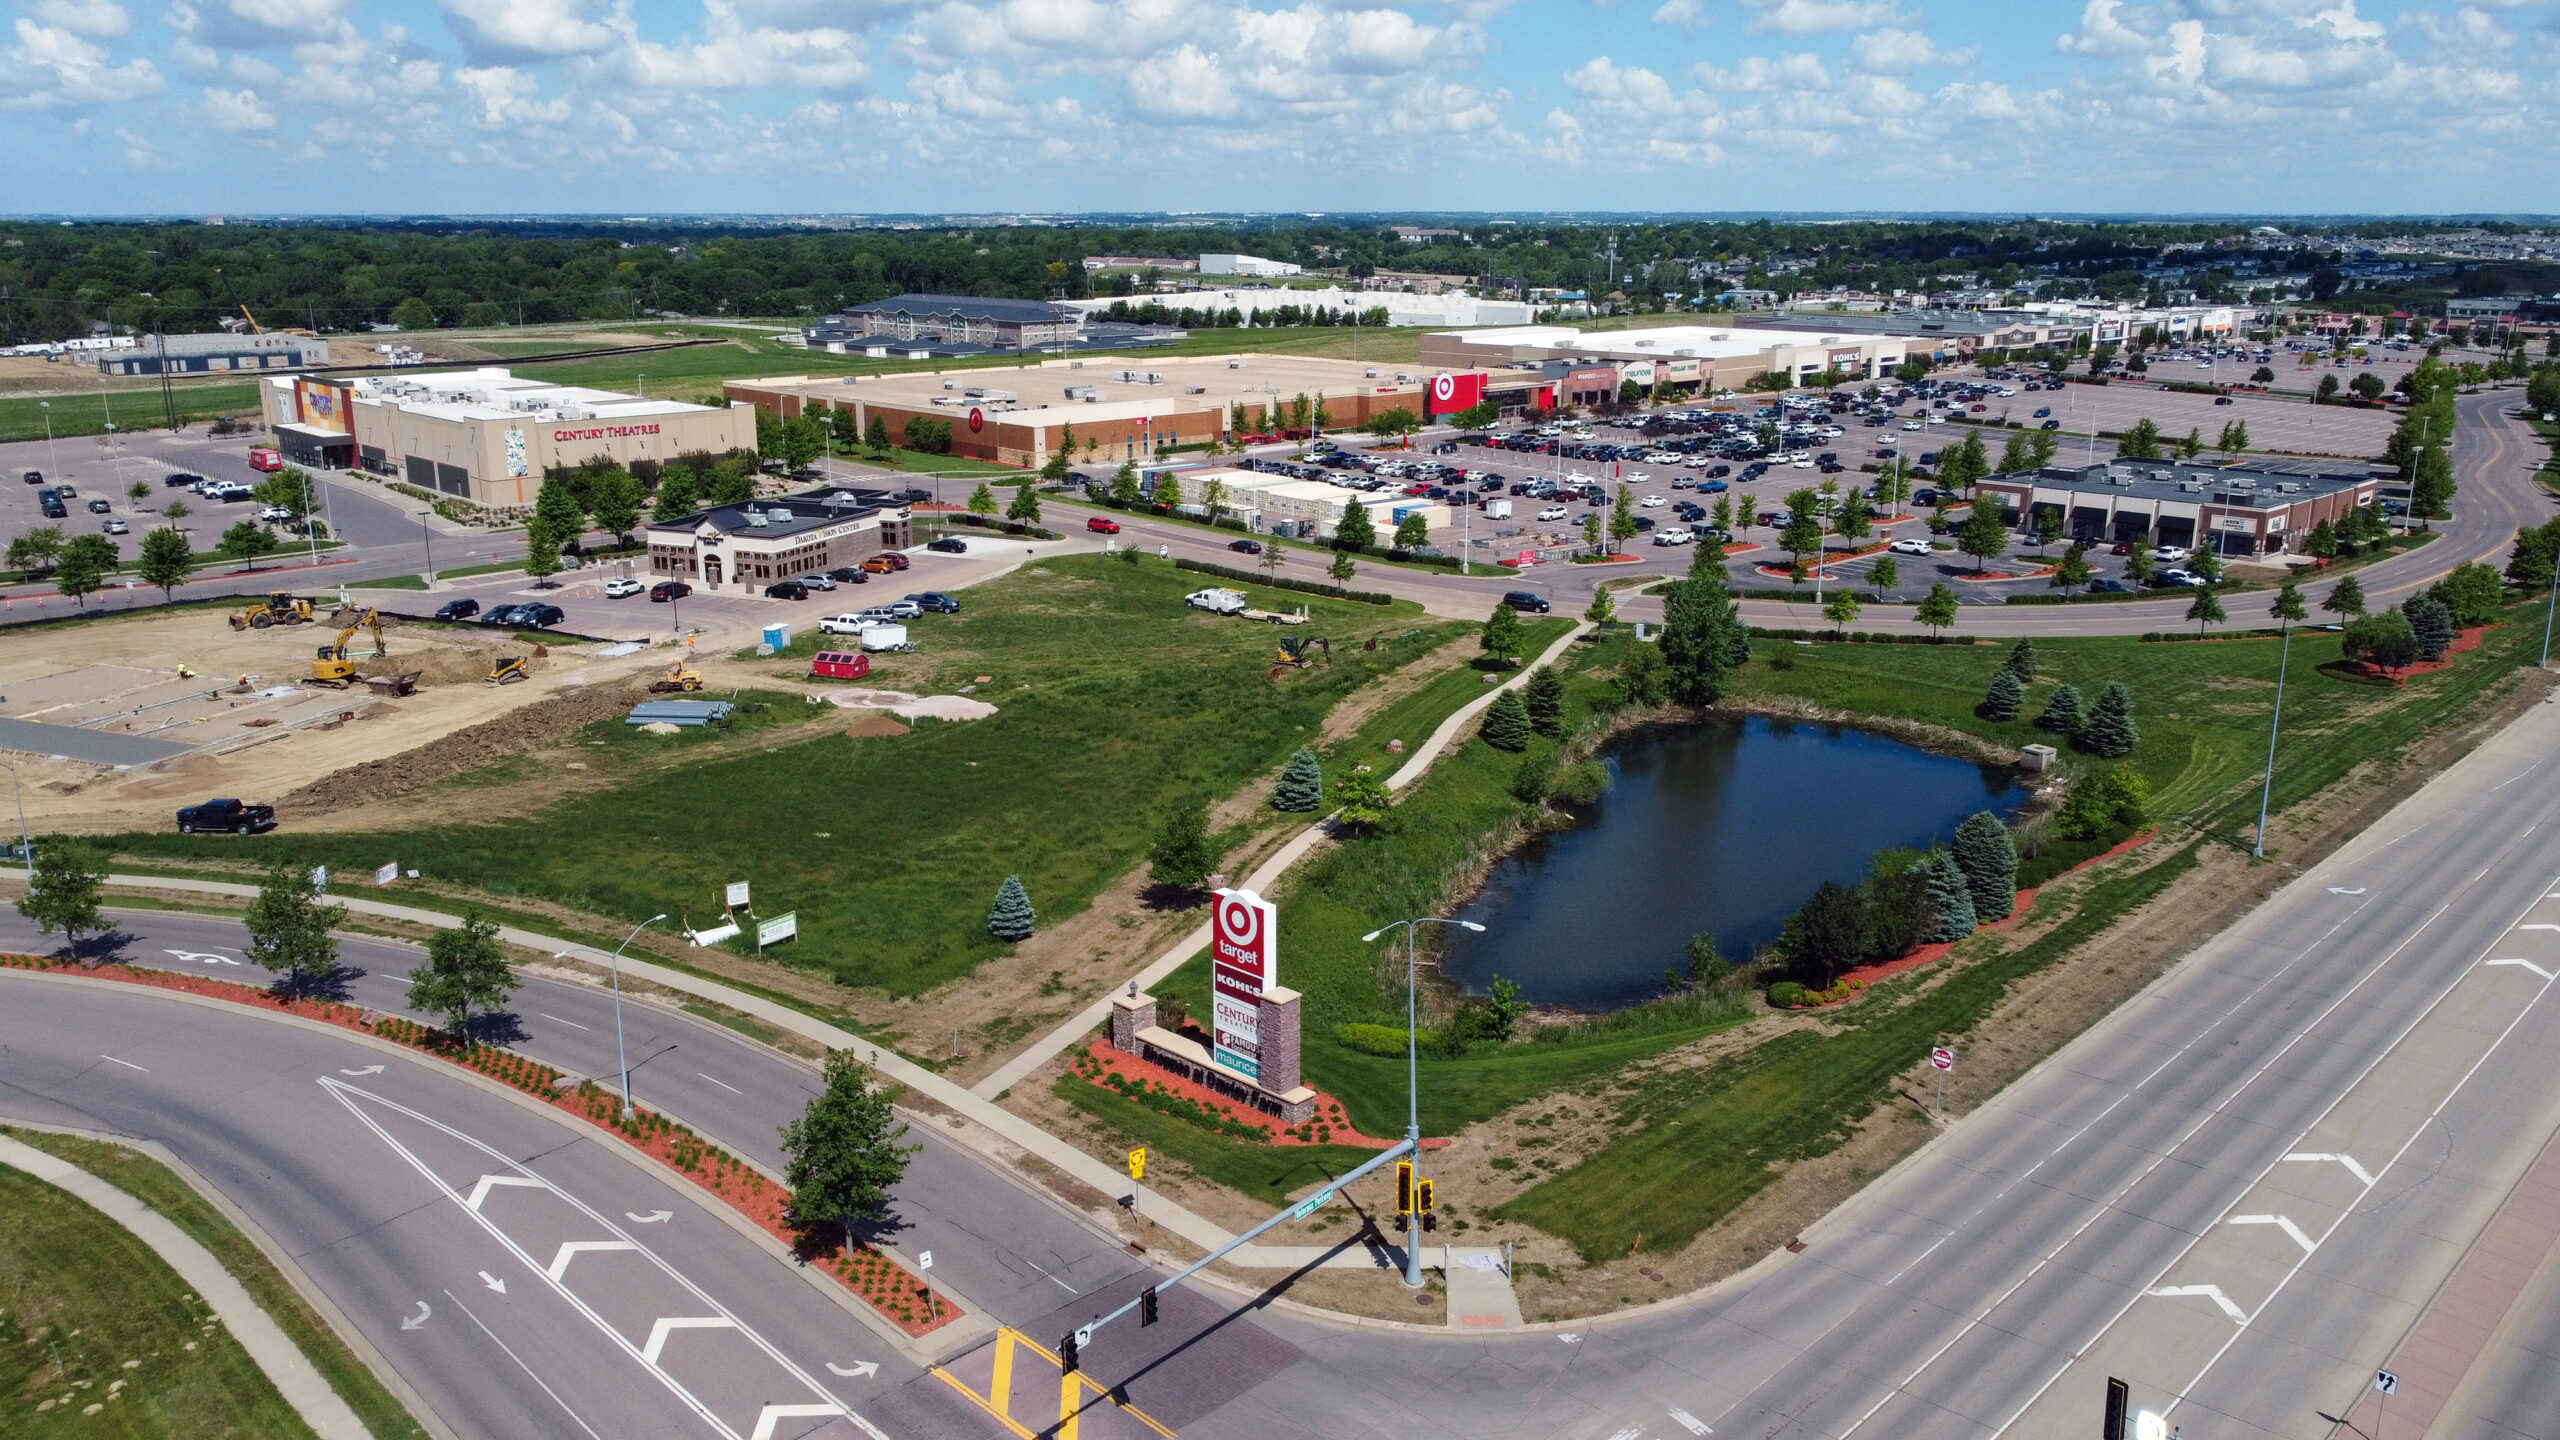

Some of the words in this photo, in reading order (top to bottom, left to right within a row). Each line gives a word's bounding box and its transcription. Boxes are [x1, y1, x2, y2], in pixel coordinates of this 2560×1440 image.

[1832, 352, 1860, 363] KOHL'S
[554, 428, 604, 442] CENTURY
[606, 424, 661, 438] THEATRES
[794, 533, 818, 545] DAKOTA
[839, 522, 860, 534] CENTER
[1219, 939, 1258, 965] target
[1217, 973, 1261, 997] KOHL'S
[1216, 1002, 1260, 1029] CENTURY
[1216, 1051, 1257, 1075] maurice
